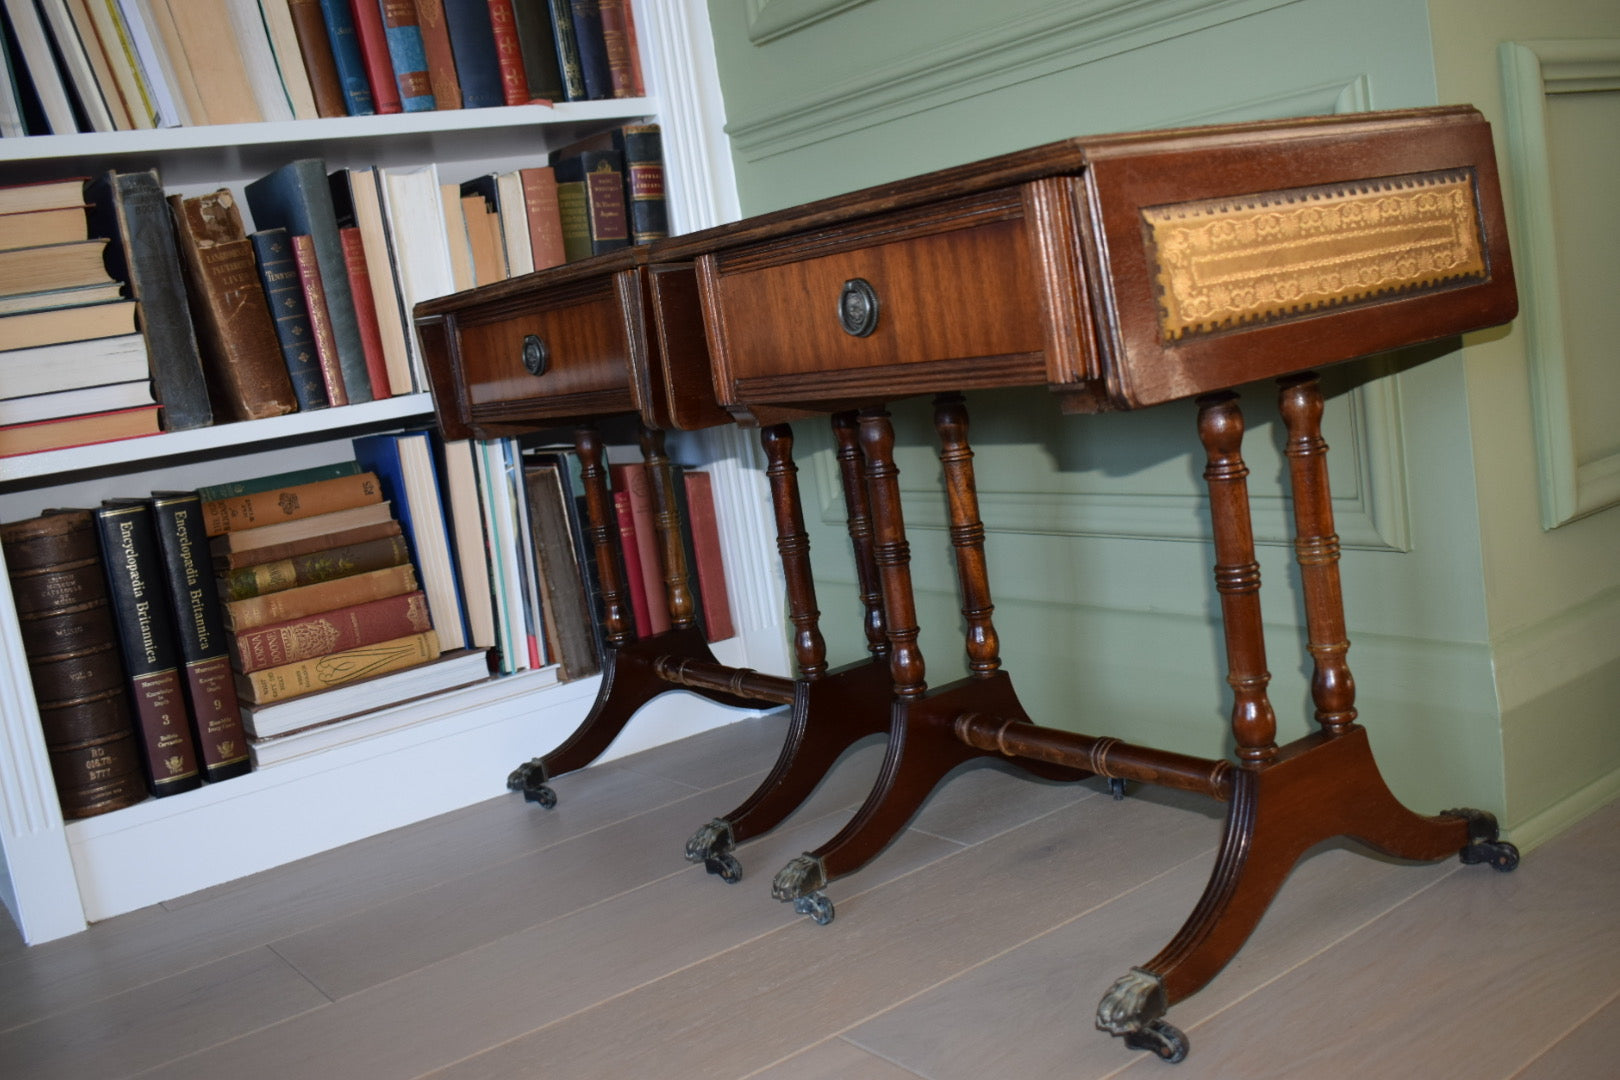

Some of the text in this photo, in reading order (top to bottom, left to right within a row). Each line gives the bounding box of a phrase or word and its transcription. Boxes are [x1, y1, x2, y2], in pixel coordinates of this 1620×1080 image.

[120, 520, 157, 664] Encyclopædia Britannica
[174, 510, 211, 651] Encyclopædia Britannica
[252, 633, 266, 668] LORNA
[266, 631, 280, 663] DOONE
[161, 714, 170, 726] 3
[213, 700, 222, 710] 9
